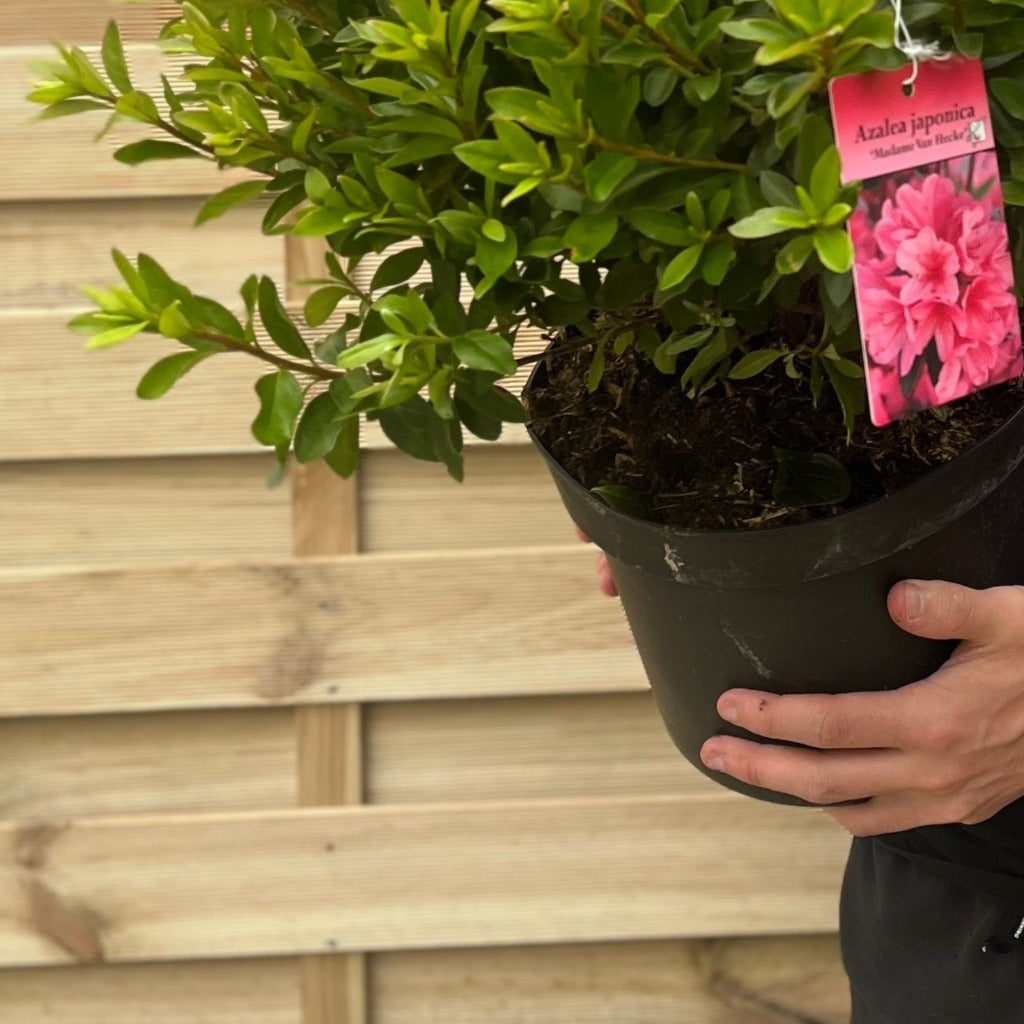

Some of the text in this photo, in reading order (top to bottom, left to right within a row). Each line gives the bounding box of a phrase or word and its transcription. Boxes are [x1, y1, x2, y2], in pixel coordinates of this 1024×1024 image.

[855, 104, 975, 144] Azalea japonica
[916, 138, 933, 150] Van
